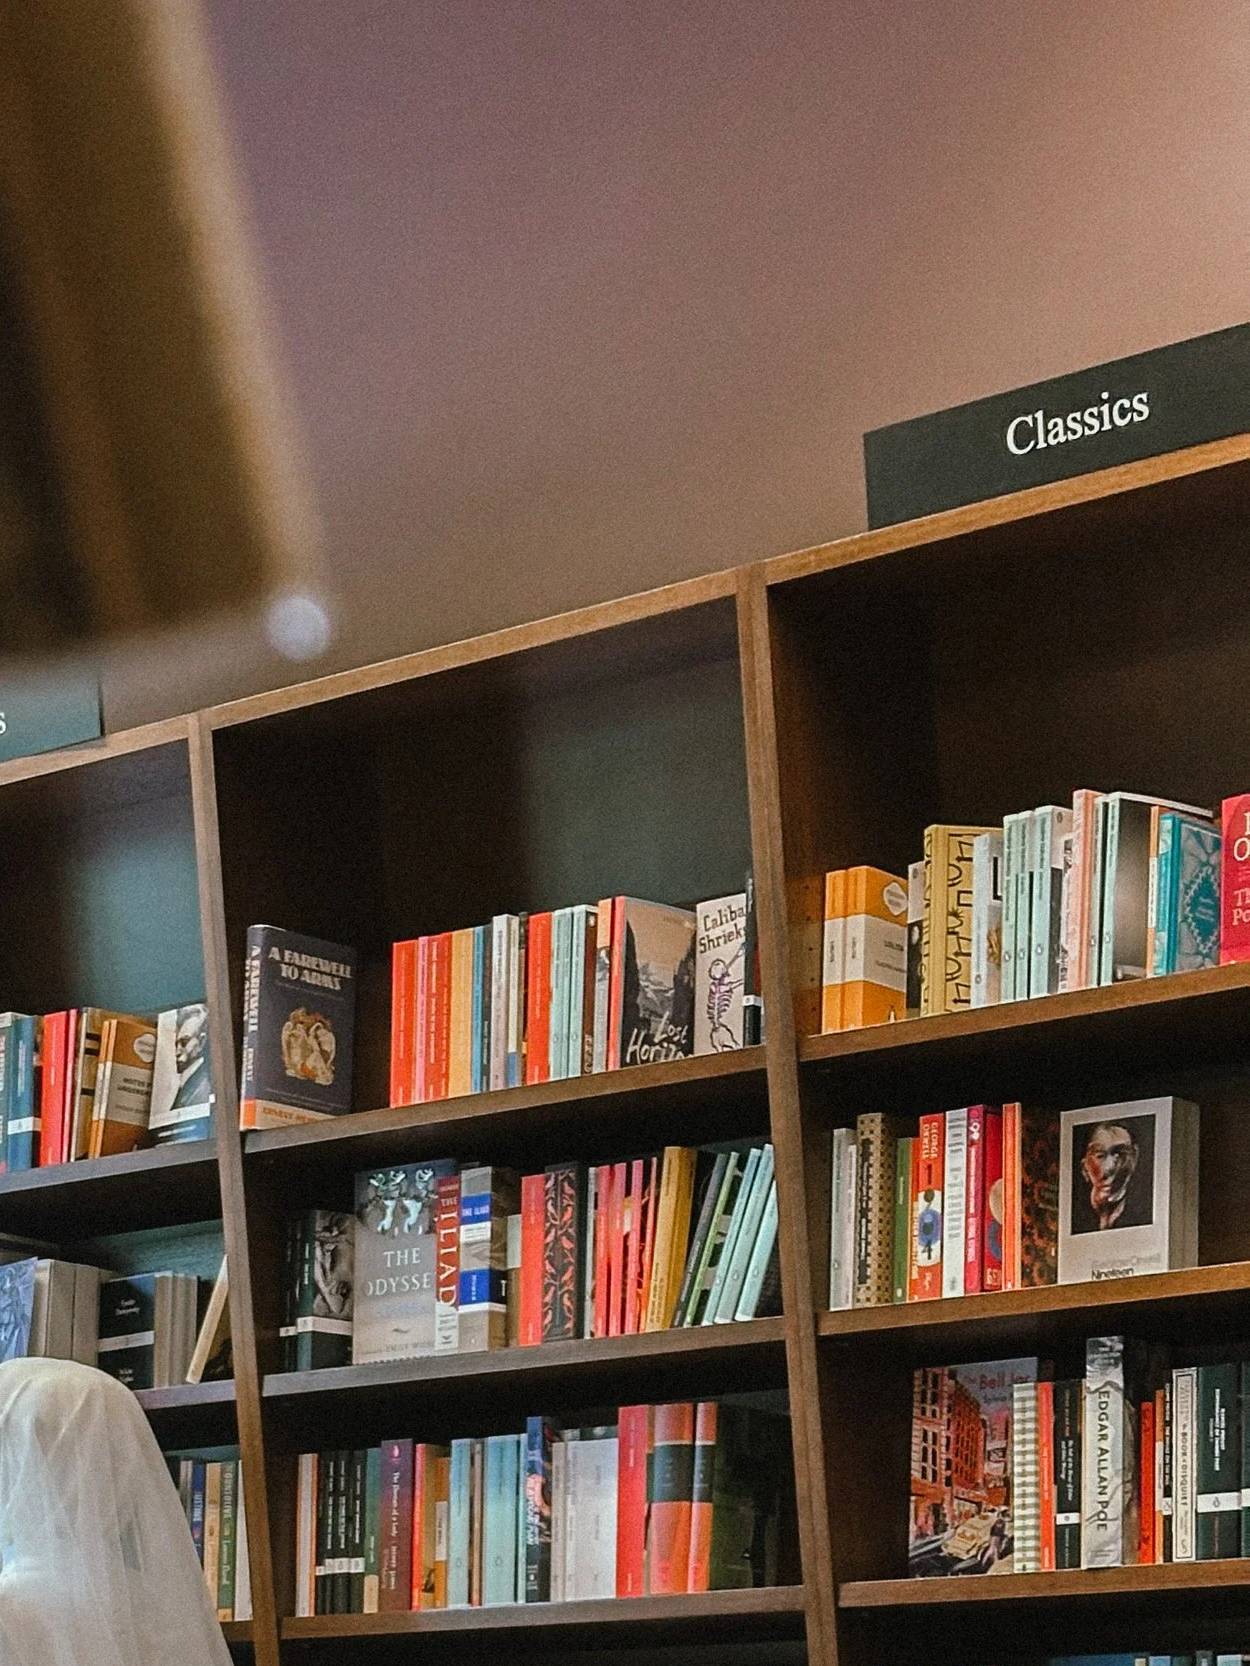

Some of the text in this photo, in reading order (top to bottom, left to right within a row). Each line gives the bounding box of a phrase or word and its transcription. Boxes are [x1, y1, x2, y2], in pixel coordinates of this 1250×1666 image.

[1006, 391, 1150, 455] Classics
[703, 905, 746, 932] Caliba
[268, 946, 353, 978] A FAREWELL
[280, 963, 342, 990] TO ARMS
[653, 1011, 688, 1043] Lost
[626, 1029, 694, 1065] Horiz
[383, 1247, 421, 1267] THE
[439, 1210, 459, 1309] ILIAD
[366, 1272, 436, 1297] ODYSSE
[1095, 1390, 1111, 1532] EDGAR ALLAN POE
